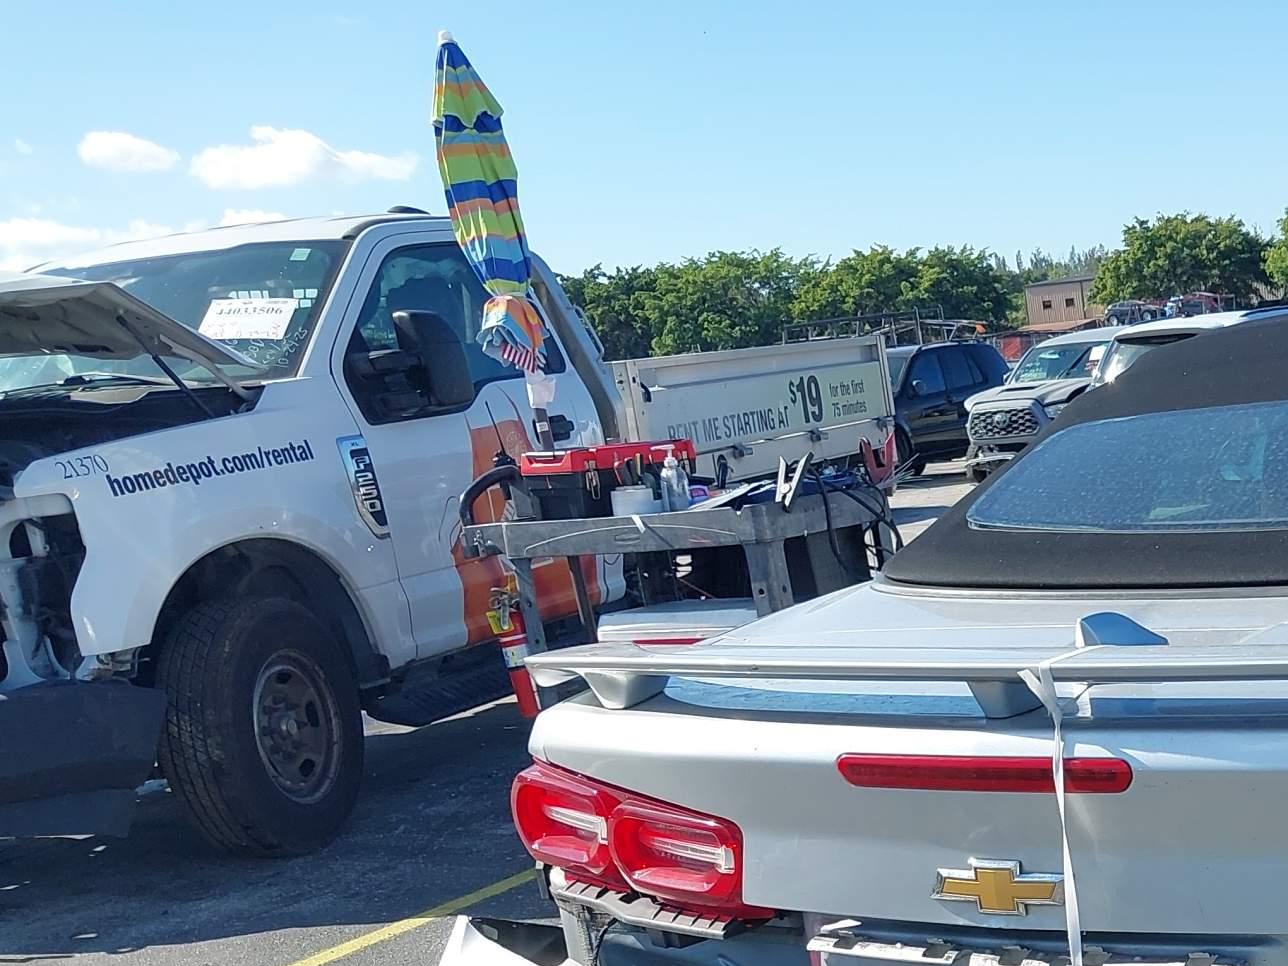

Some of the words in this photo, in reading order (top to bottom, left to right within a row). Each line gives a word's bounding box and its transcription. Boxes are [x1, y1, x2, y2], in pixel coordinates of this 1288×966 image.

[829, 383, 839, 398] for
[840, 381, 851, 396] the
[851, 379, 865, 394] first
[702, 417, 721, 442] ME
[722, 407, 776, 439] STARTING
[778, 405, 790, 429] AT
[789, 375, 823, 424] $19
[832, 402, 841, 417] 75
[842, 400, 867, 416] minutes
[55, 454, 109, 479] 21370
[106, 439, 314, 497] homedepot.com/rental
